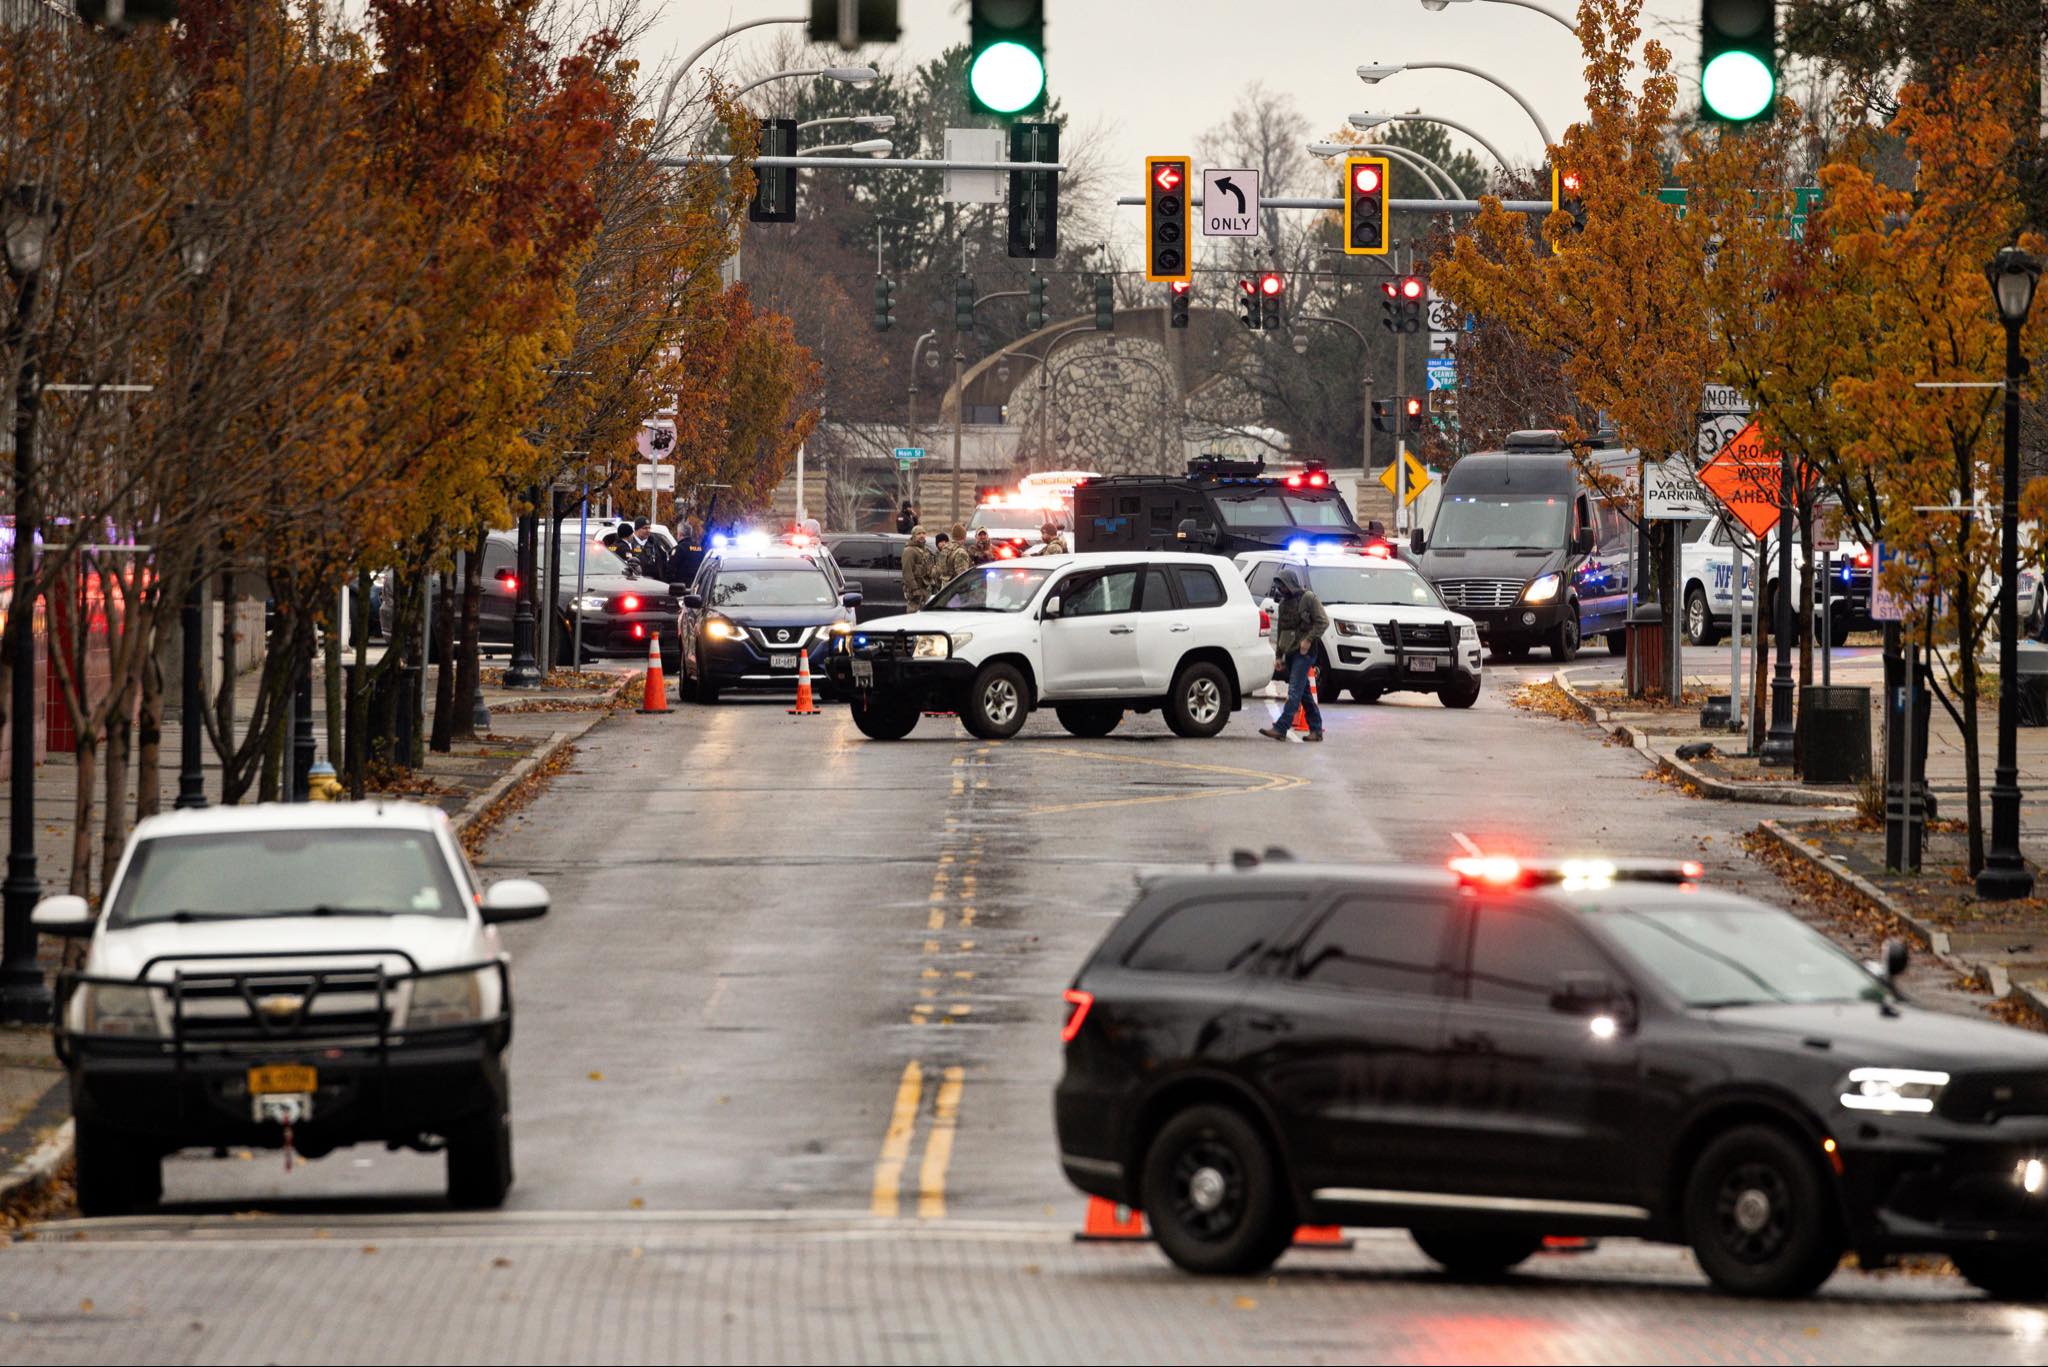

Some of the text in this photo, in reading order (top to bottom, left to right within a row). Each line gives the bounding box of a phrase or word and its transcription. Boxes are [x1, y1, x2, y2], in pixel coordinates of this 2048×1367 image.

[1211, 217, 1251, 231] ONLY
[898, 449, 912, 457] Main
[1738, 468, 1782, 481] WORK
[1656, 481, 1698, 489] VALE
[1715, 564, 1748, 589] NFD
